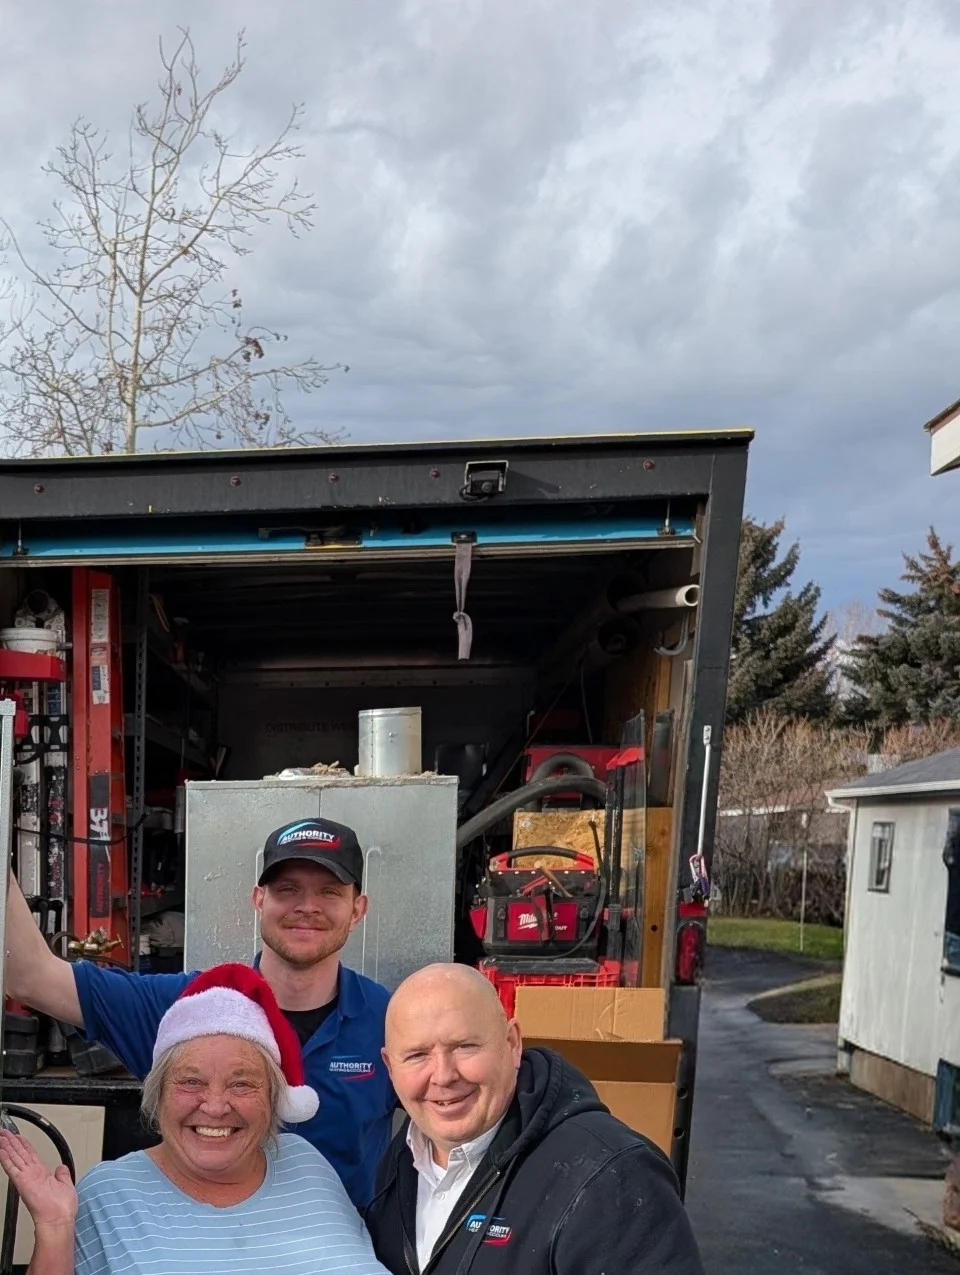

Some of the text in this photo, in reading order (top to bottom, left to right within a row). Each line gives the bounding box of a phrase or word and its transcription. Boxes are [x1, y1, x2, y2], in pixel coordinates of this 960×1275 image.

[283, 830, 334, 840] AUTHORITY
[330, 1062, 372, 1070] AUTHORITY
[470, 1220, 510, 1234] AUORITY
